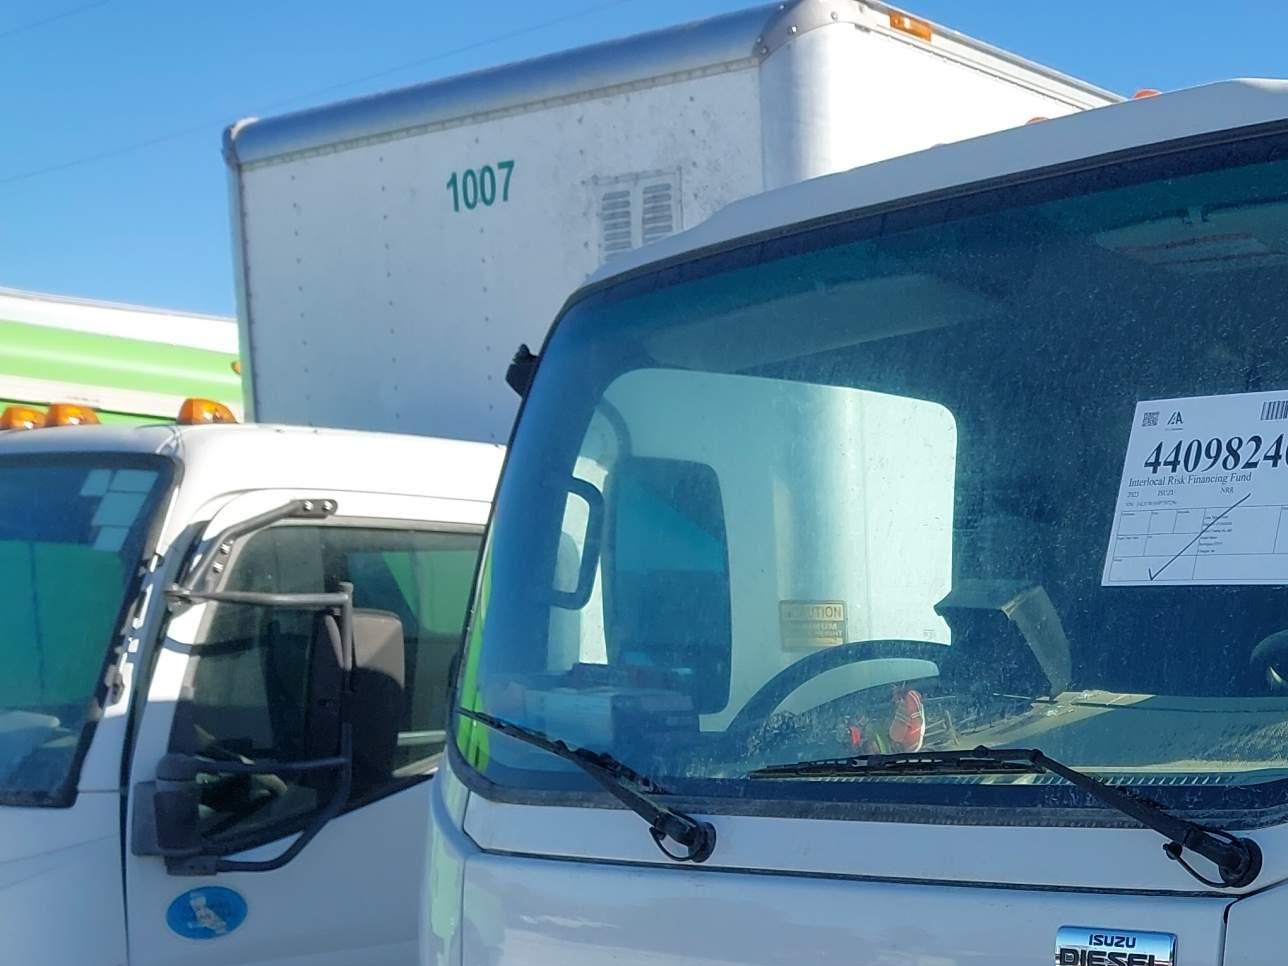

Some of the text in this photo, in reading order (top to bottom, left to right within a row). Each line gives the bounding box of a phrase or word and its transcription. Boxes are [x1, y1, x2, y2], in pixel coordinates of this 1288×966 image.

[446, 160, 515, 212] 1007
[1128, 471, 1252, 487] Interlocal Risk Financing Fund
[1088, 934, 1136, 948] ISUZU
